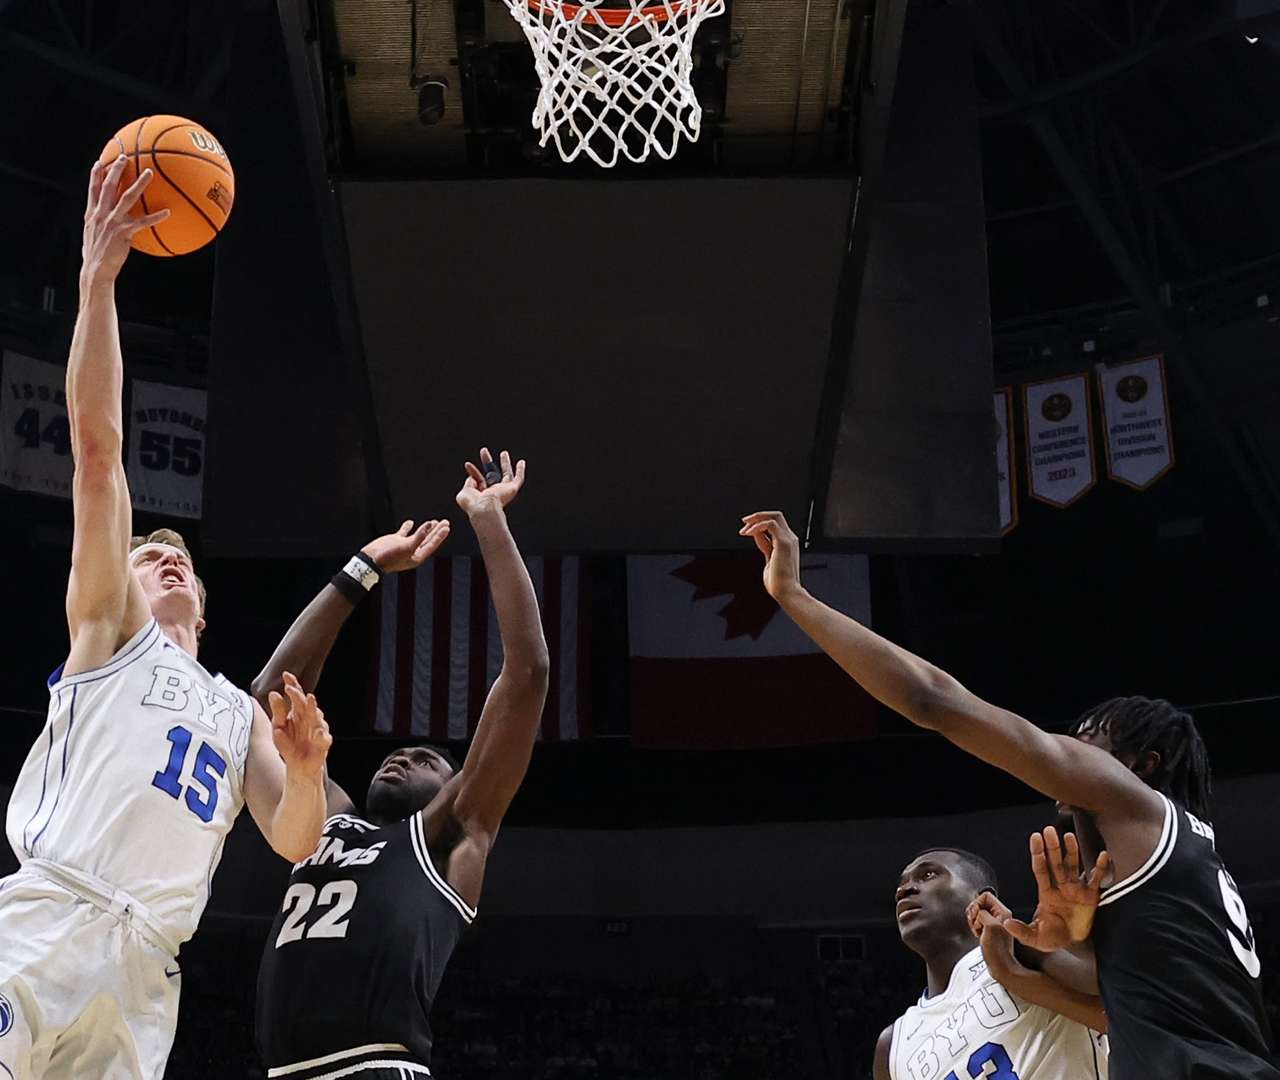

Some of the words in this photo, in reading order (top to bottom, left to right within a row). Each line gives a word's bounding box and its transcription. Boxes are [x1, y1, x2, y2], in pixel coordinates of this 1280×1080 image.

[14, 407, 70, 456] 44
[139, 429, 203, 478] 55
[141, 665, 250, 772] BYU
[151, 725, 228, 823] 15
[291, 835, 388, 875] AMS
[275, 879, 358, 949] 22
